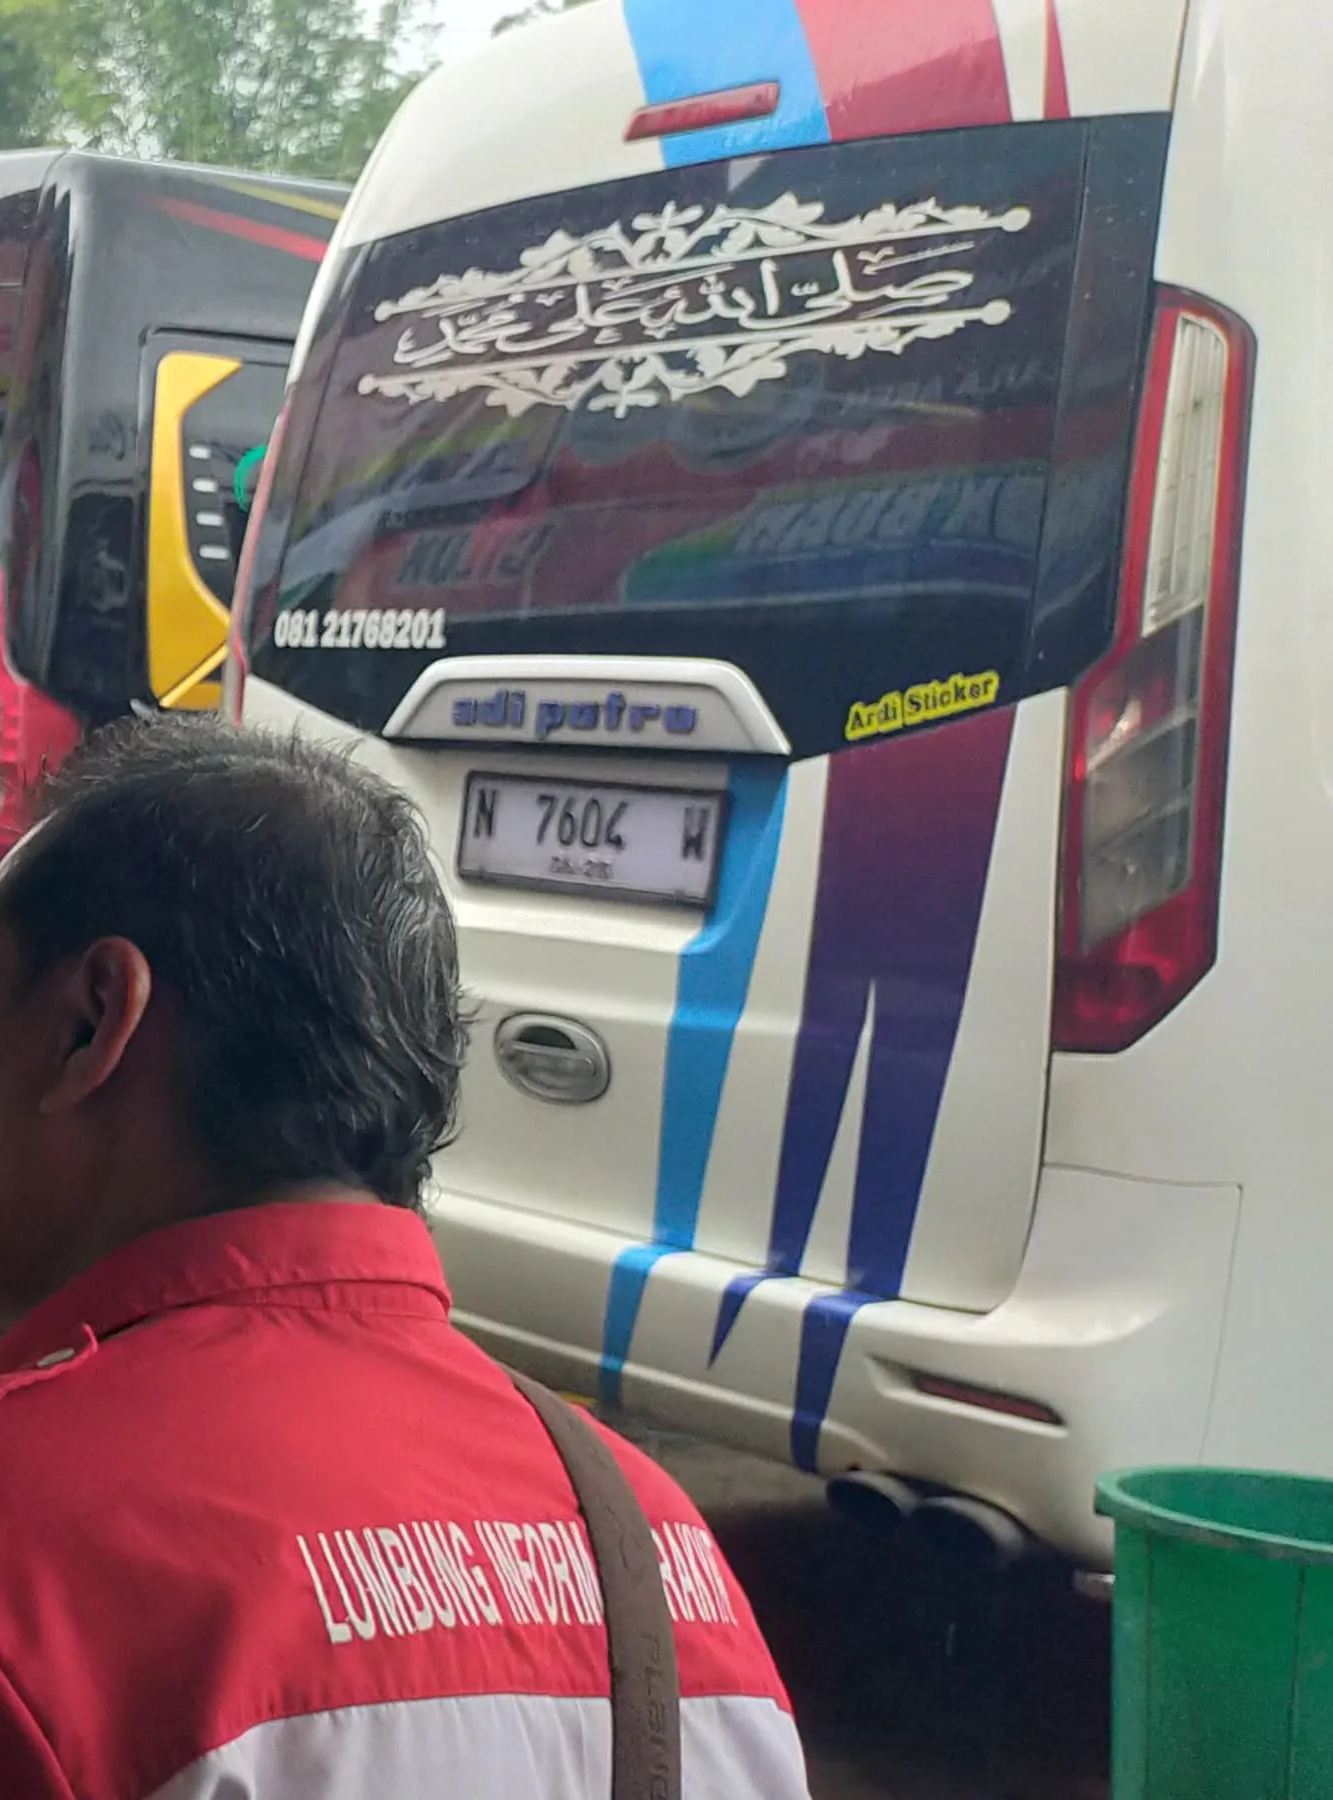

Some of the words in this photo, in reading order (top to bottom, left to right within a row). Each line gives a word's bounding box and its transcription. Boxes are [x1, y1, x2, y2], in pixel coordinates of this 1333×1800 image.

[274, 608, 319, 648] 081
[319, 607, 448, 650] 21768201
[452, 690, 526, 728] adi
[849, 696, 898, 733] Ardi
[906, 676, 995, 717] Sticker
[473, 787, 498, 840] N
[536, 792, 628, 851] 7604
[295, 1519, 503, 1645] LUMBUNG
